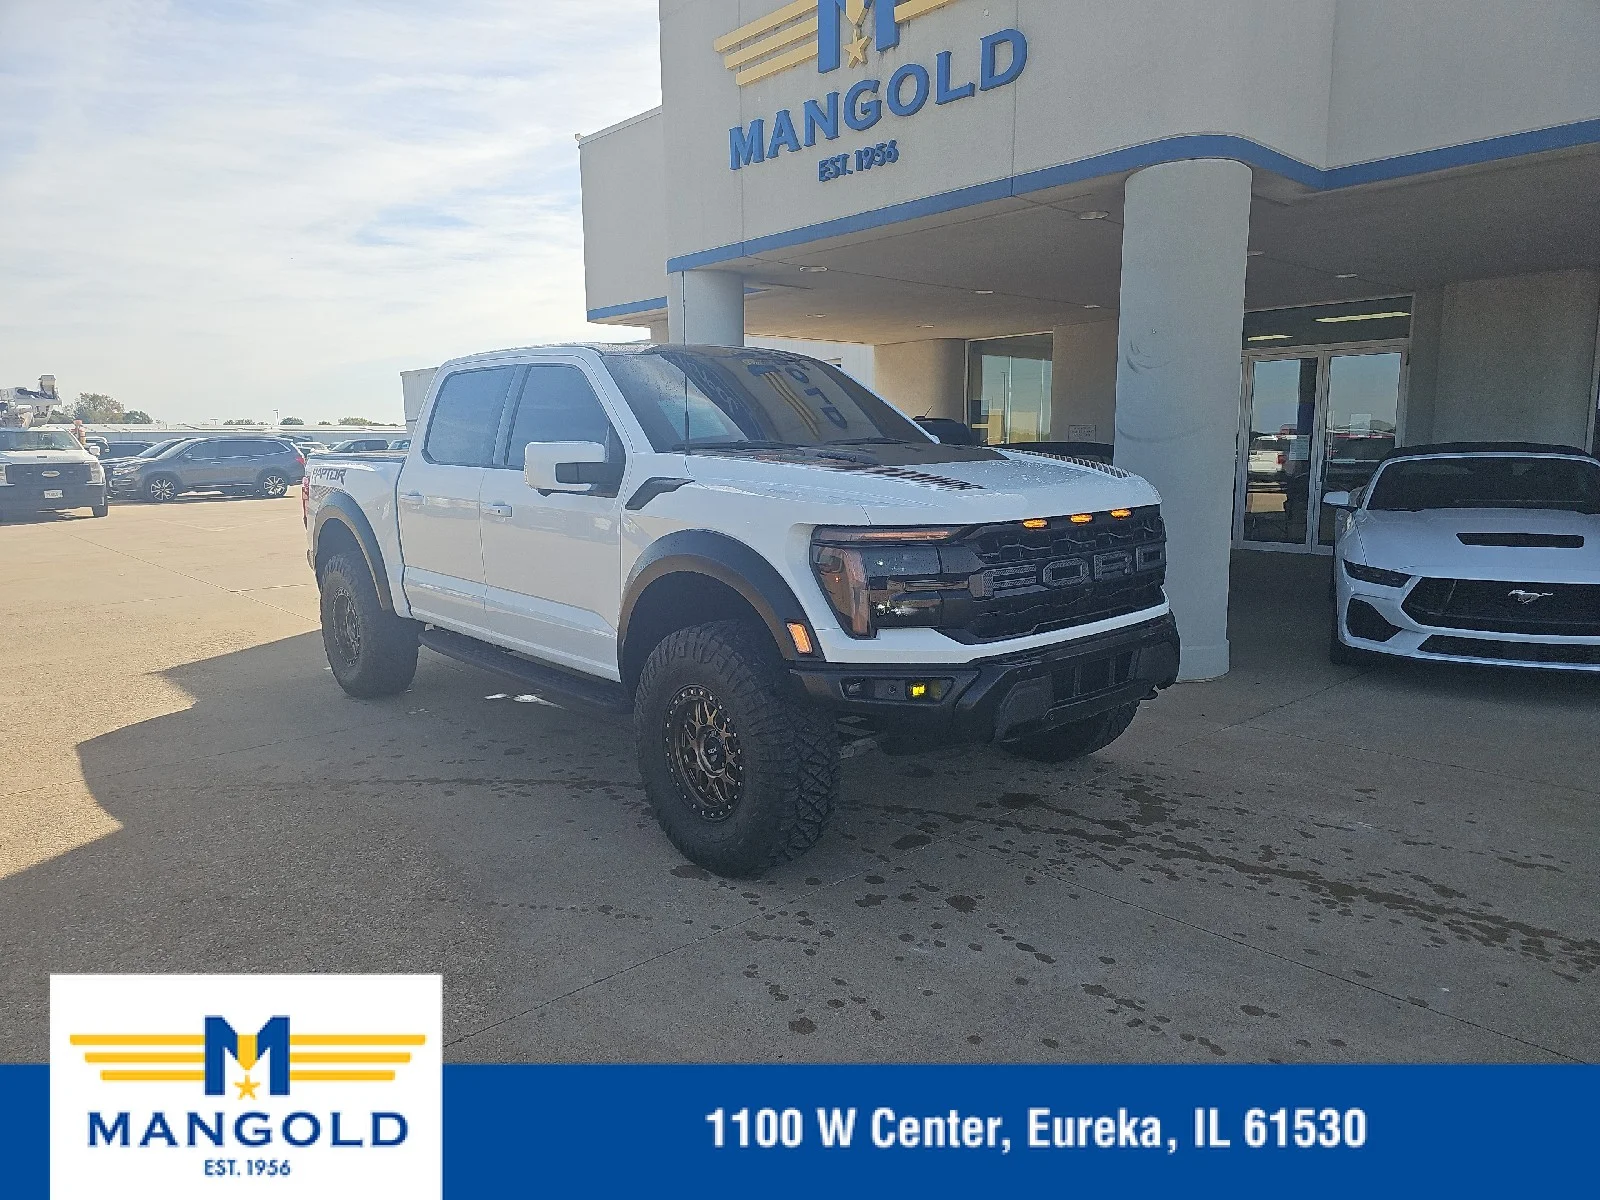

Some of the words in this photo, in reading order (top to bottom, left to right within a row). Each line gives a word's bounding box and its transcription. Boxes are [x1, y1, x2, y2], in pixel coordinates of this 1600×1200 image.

[728, 28, 1028, 171] MANGOLD
[818, 153, 853, 182] EST.
[855, 139, 899, 171] 1956
